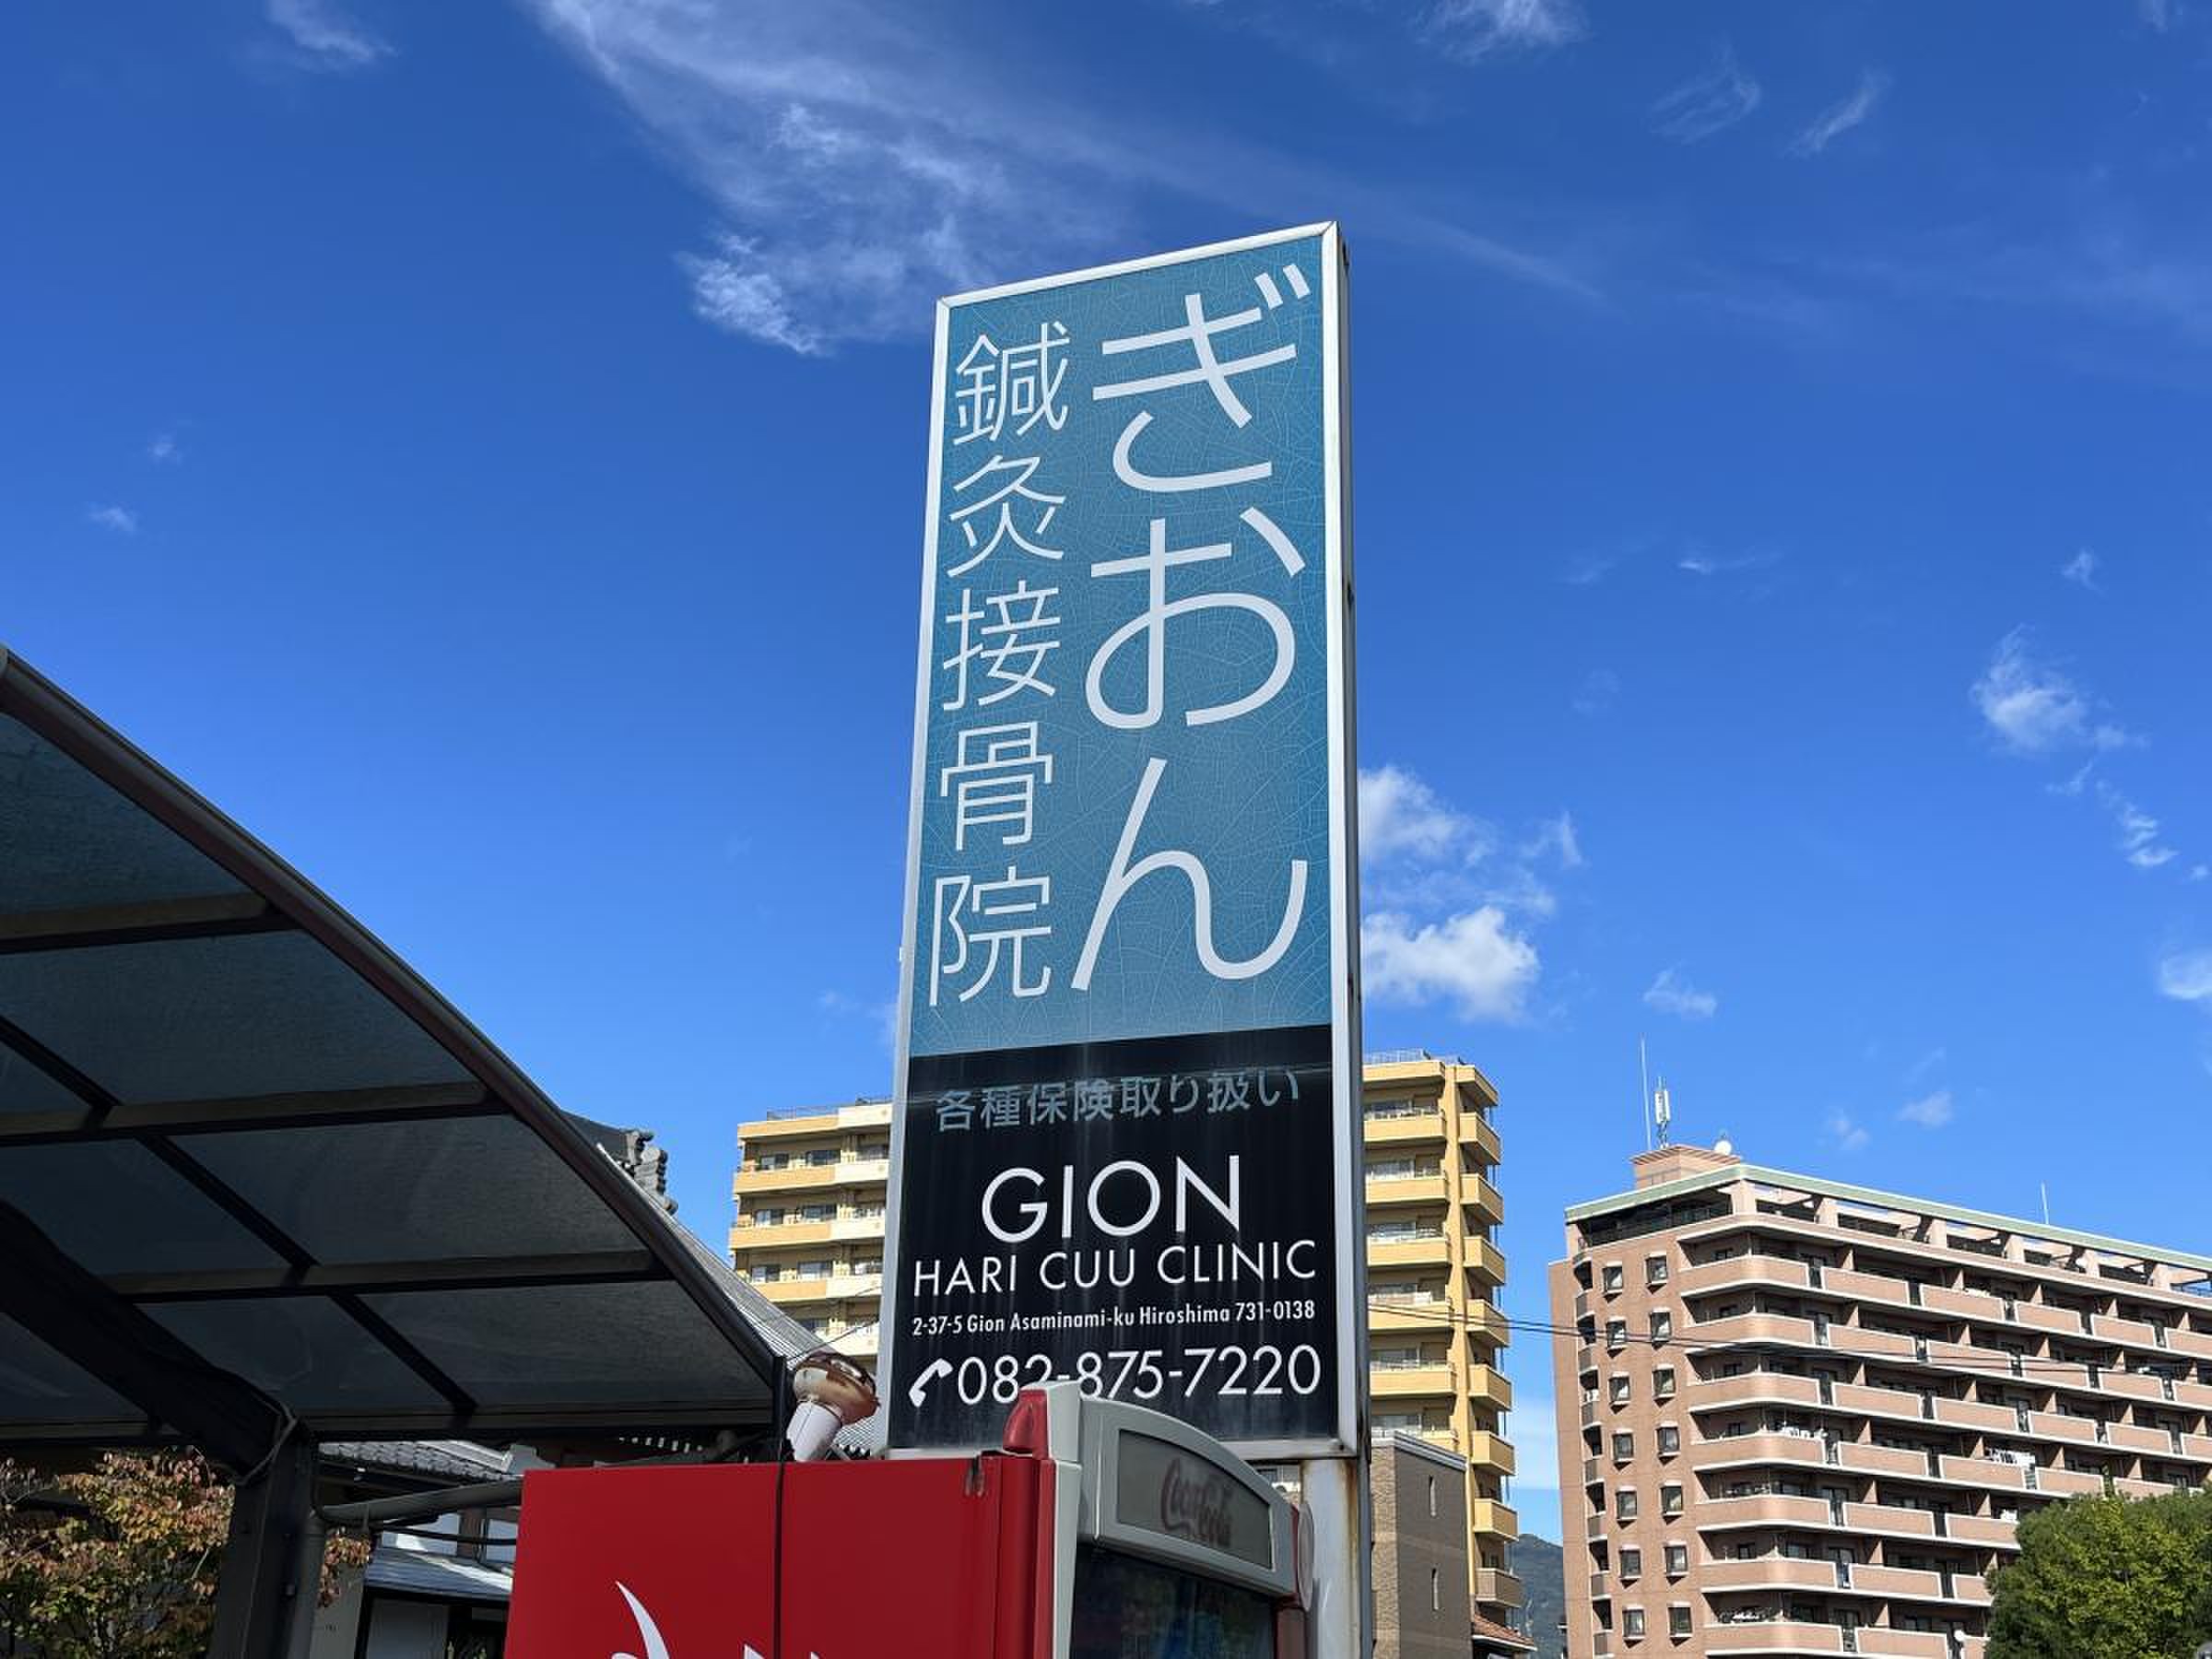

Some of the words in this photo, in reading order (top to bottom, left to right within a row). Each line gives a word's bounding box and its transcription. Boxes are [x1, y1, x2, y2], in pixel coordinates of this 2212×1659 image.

[1071, 264, 1312, 992] ぎおん
[929, 320, 1071, 1006] 鍼灸接骨院
[935, 1069, 1300, 1133] 各種保険取り扱い
[982, 1155, 1240, 1243] GION
[913, 1254, 1017, 1297] HARI
[1040, 1248, 1135, 1290] CUU
[1157, 1240, 1316, 1285] CLINIC
[912, 1316, 963, 1336] 2-37-5
[967, 1313, 1005, 1333] Gion
[1009, 1306, 1135, 1331] Asaminami-ku
[1139, 1302, 1230, 1325] Hiroshima
[1235, 1300, 1315, 1322] 731-0138
[958, 1344, 1322, 1405] 082-875-7220
